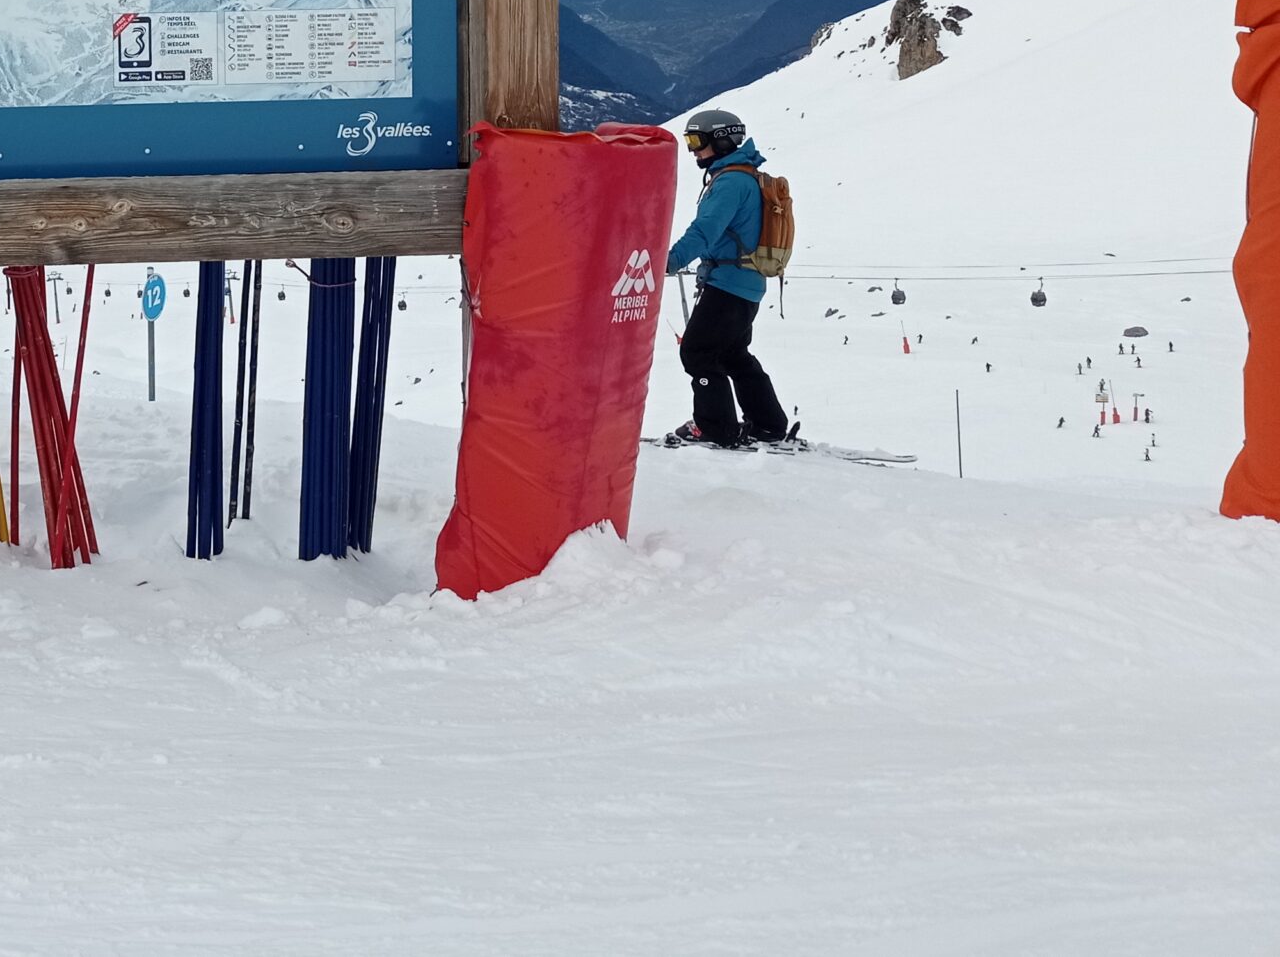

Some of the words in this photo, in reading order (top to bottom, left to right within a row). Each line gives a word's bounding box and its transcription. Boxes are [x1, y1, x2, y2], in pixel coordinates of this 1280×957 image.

[337, 124, 360, 139] les
[346, 111, 378, 156] 3
[377, 122, 432, 137] vallées
[147, 285, 161, 308] 12
[613, 295, 648, 310] MERIBEL
[611, 308, 646, 323] ALPINA
